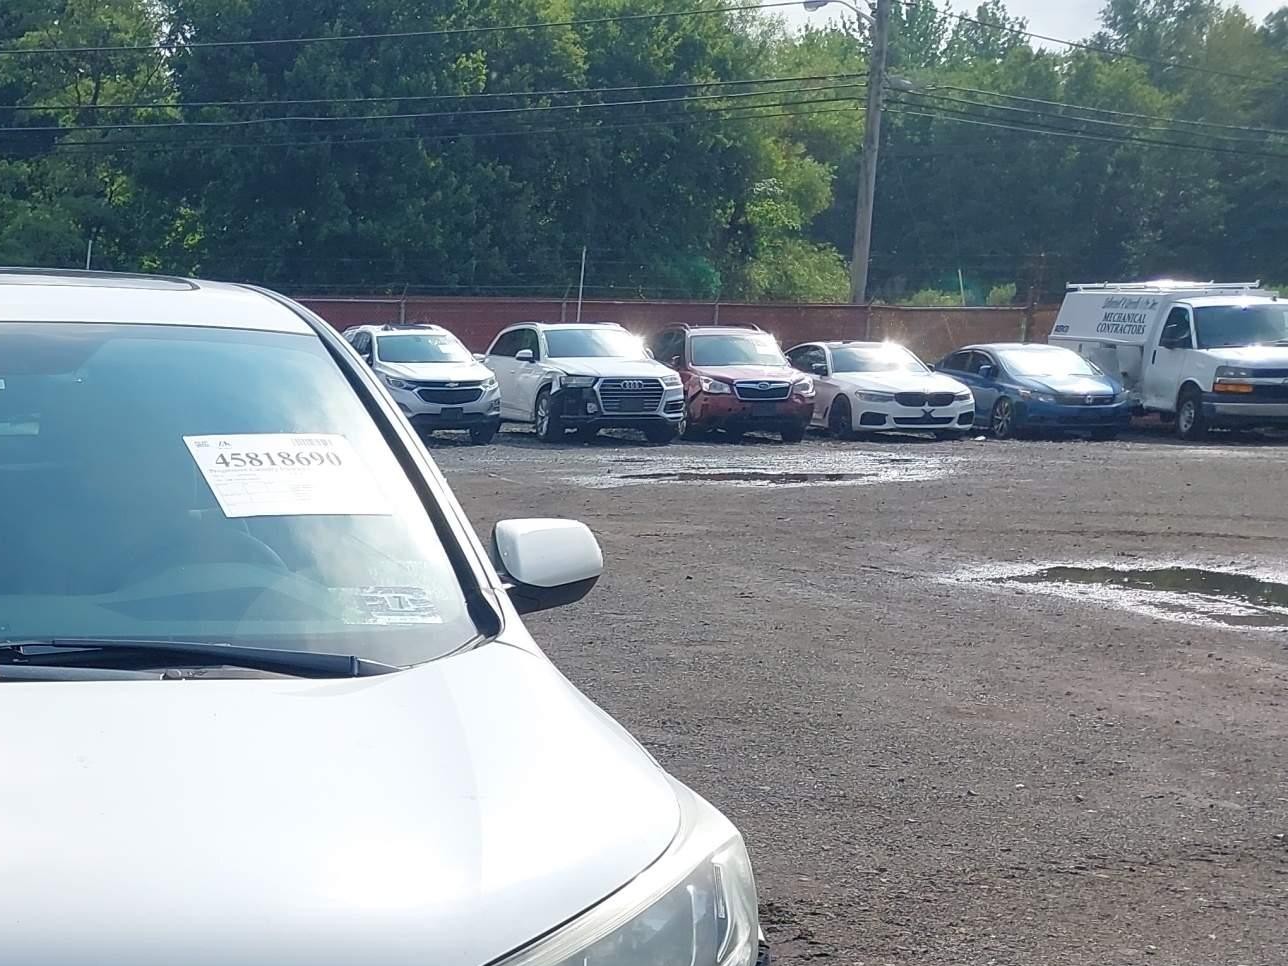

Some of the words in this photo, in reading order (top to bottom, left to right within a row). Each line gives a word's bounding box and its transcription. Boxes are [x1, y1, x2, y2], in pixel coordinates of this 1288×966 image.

[1103, 312, 1146, 323] MECHANICAL
[1096, 323, 1146, 335] CONTRACTORS
[215, 451, 343, 468] 45818690
